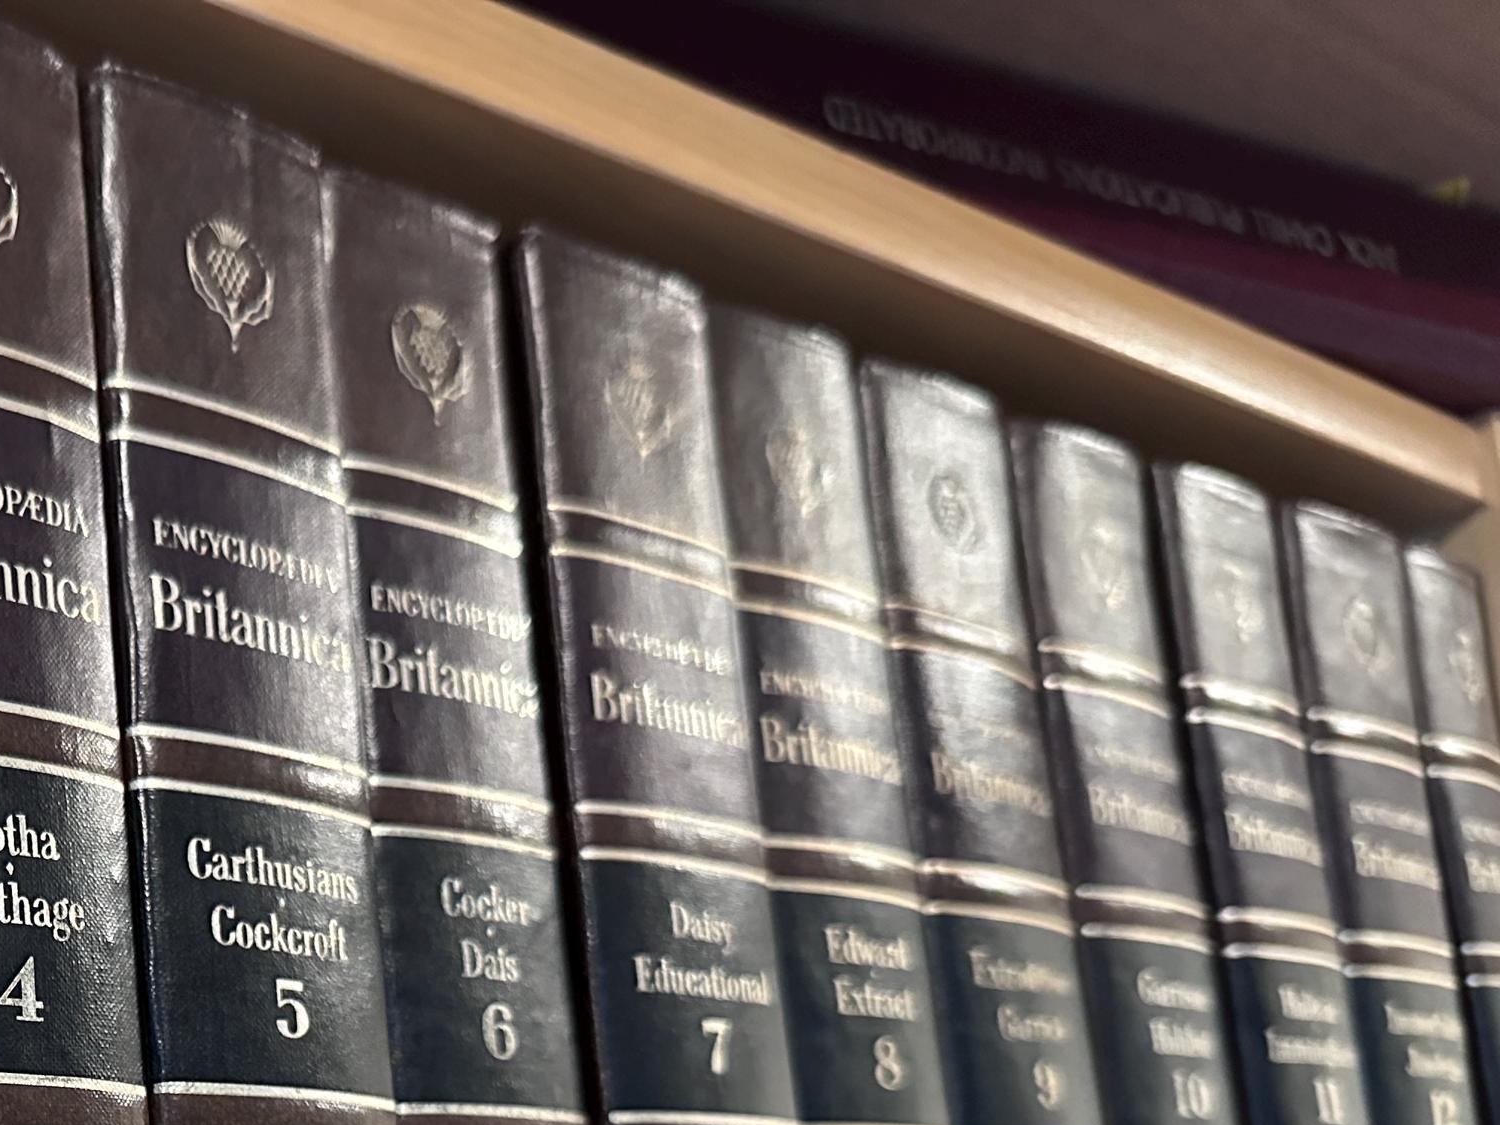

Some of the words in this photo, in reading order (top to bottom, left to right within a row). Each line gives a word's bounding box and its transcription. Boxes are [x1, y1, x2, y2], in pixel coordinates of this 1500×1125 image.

[150, 572, 352, 674] Britannica
[186, 837, 360, 905] Carthusians
[441, 877, 531, 926] Cocker
[669, 900, 734, 956] Daisy
[211, 905, 348, 962] Cockcroft
[460, 938, 520, 982] Dais
[633, 954, 771, 1006] Educational
[275, 978, 310, 1039] 5
[482, 1002, 518, 1060] 6
[701, 1017, 732, 1075] 7
[873, 1035, 904, 1091] 8
[1033, 1059, 1062, 1111] 9
[1173, 1067, 1214, 1121] 10
[1314, 1074, 1346, 1125] 11
